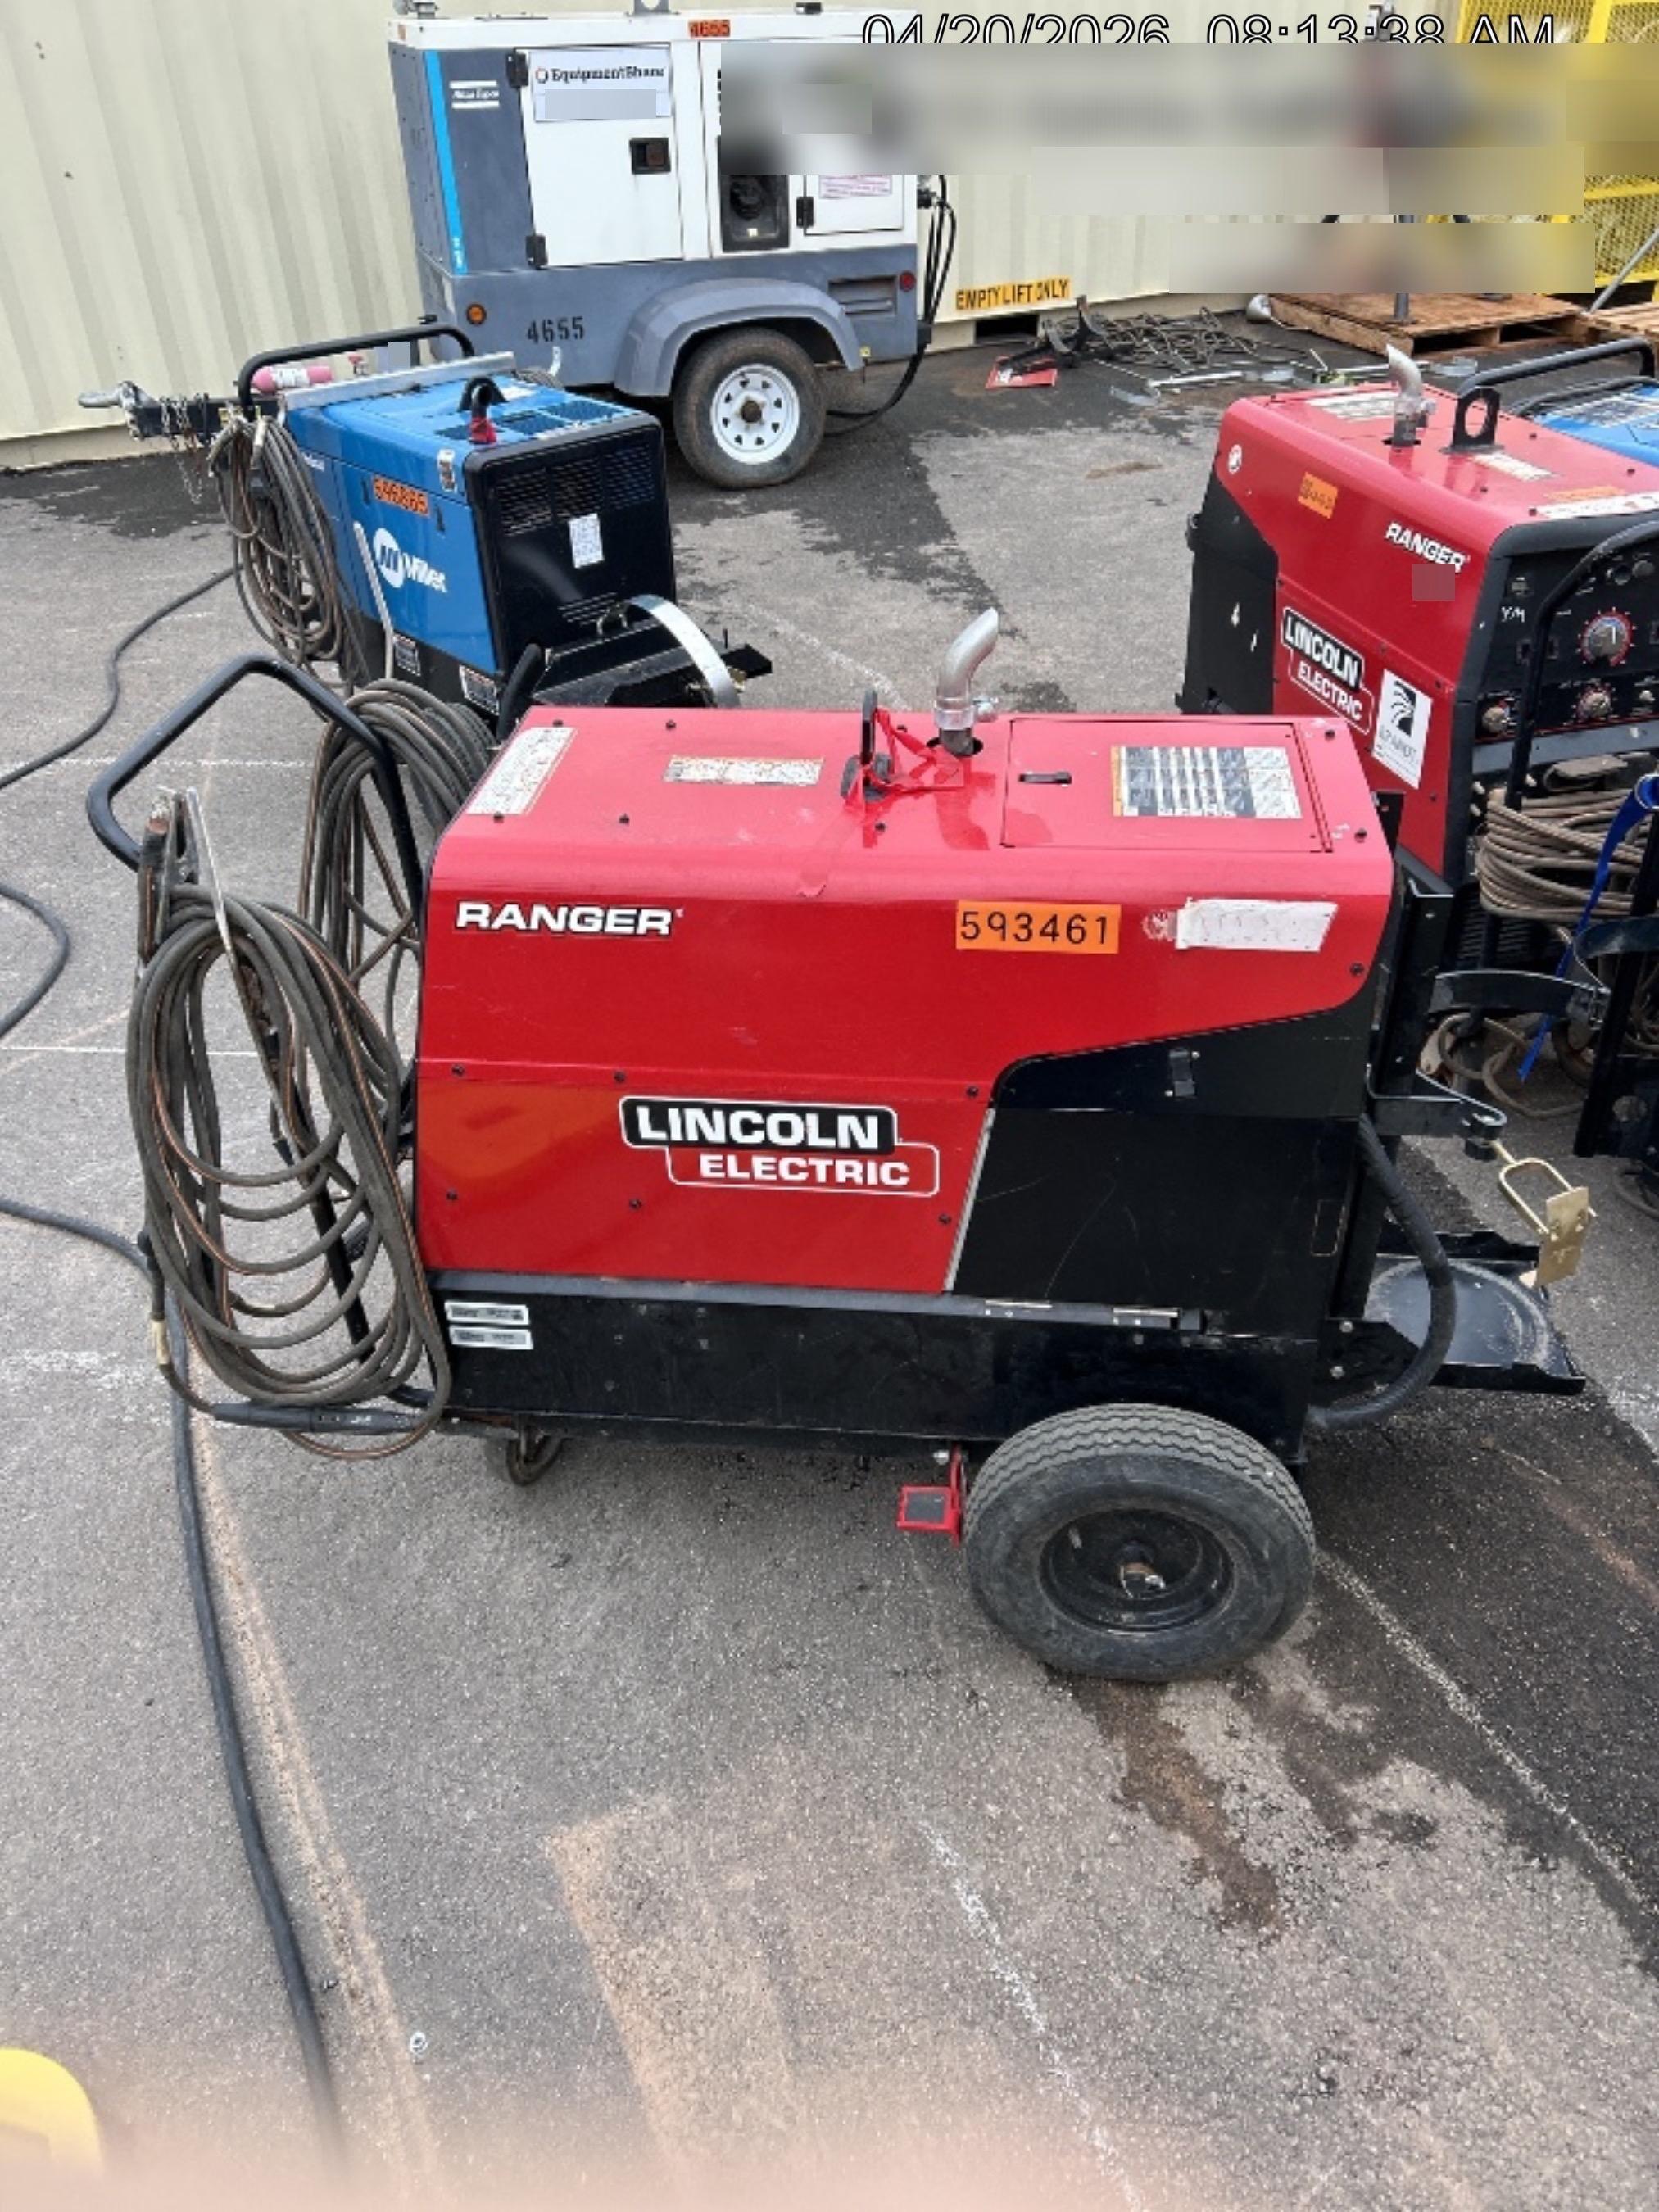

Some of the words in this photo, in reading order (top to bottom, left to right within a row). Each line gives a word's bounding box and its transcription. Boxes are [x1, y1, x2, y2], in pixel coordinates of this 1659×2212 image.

[1002, 283, 1032, 304] LIFT
[527, 316, 583, 343] 4655
[1384, 522, 1466, 573] RANGER
[1285, 615, 1358, 687] LINCOLN
[1298, 660, 1363, 721] ELECTRIC
[456, 901, 672, 936] RANGER
[960, 911, 1108, 945] 593461
[635, 1104, 880, 1150] LINCOLN
[699, 1153, 911, 1187] ELECTRIC
